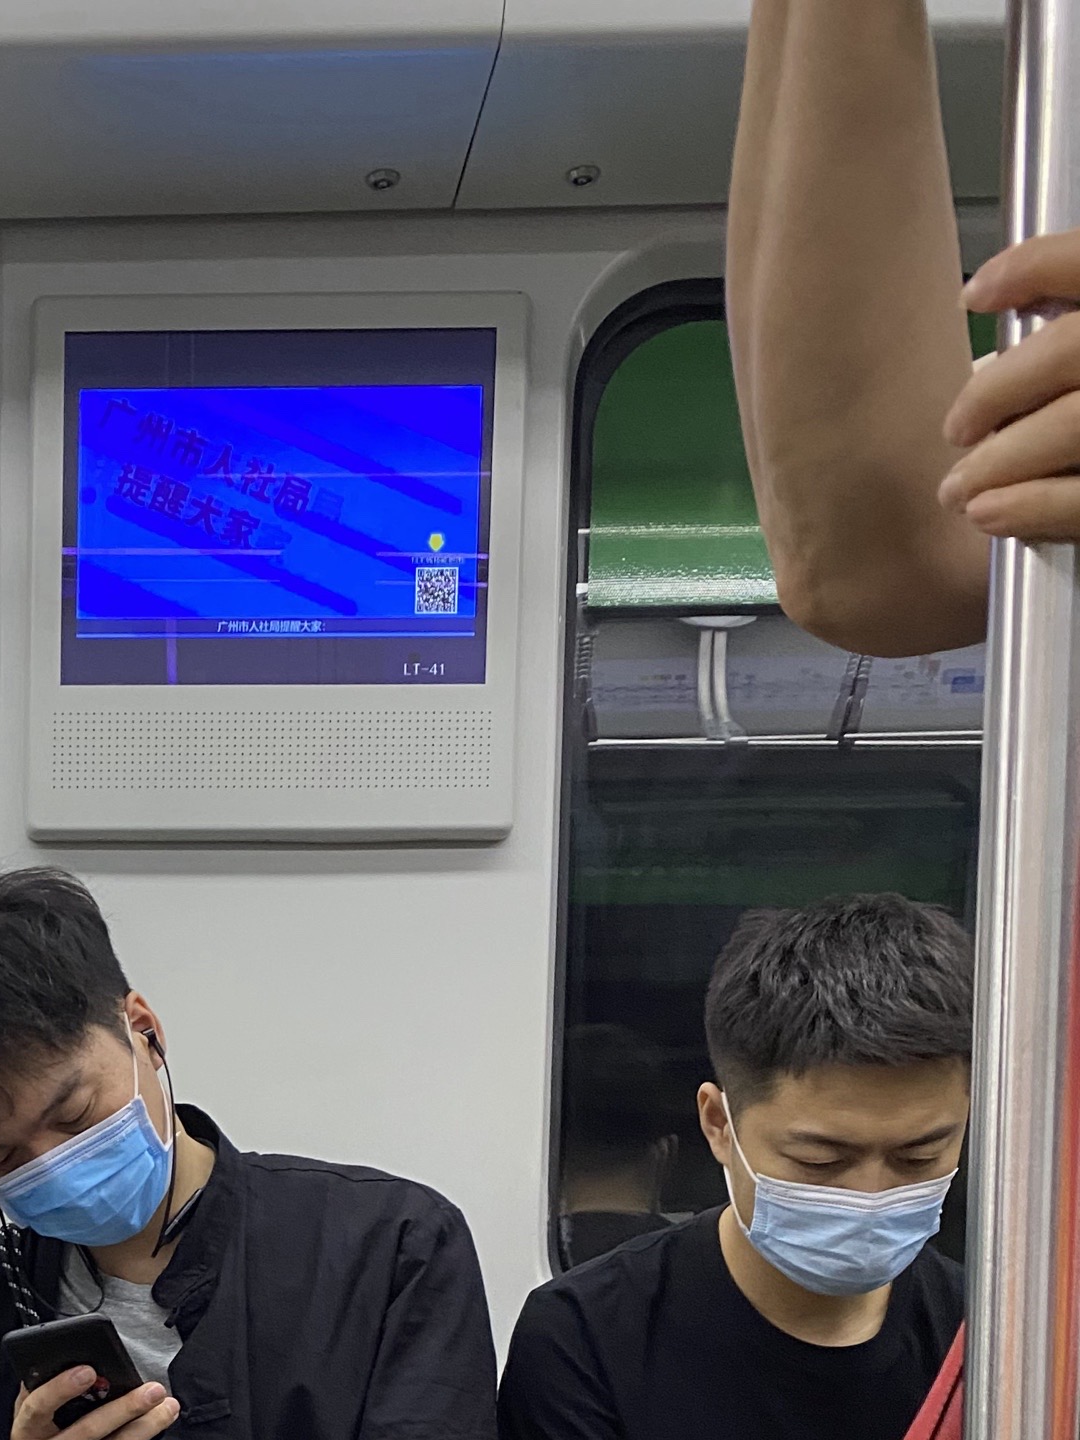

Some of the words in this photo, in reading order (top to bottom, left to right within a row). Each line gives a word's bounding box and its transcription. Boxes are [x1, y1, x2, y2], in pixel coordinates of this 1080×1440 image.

[98, 398, 314, 516] 广州市人社局
[113, 461, 261, 550] 提醒大家
[403, 663, 446, 676] LT-41
